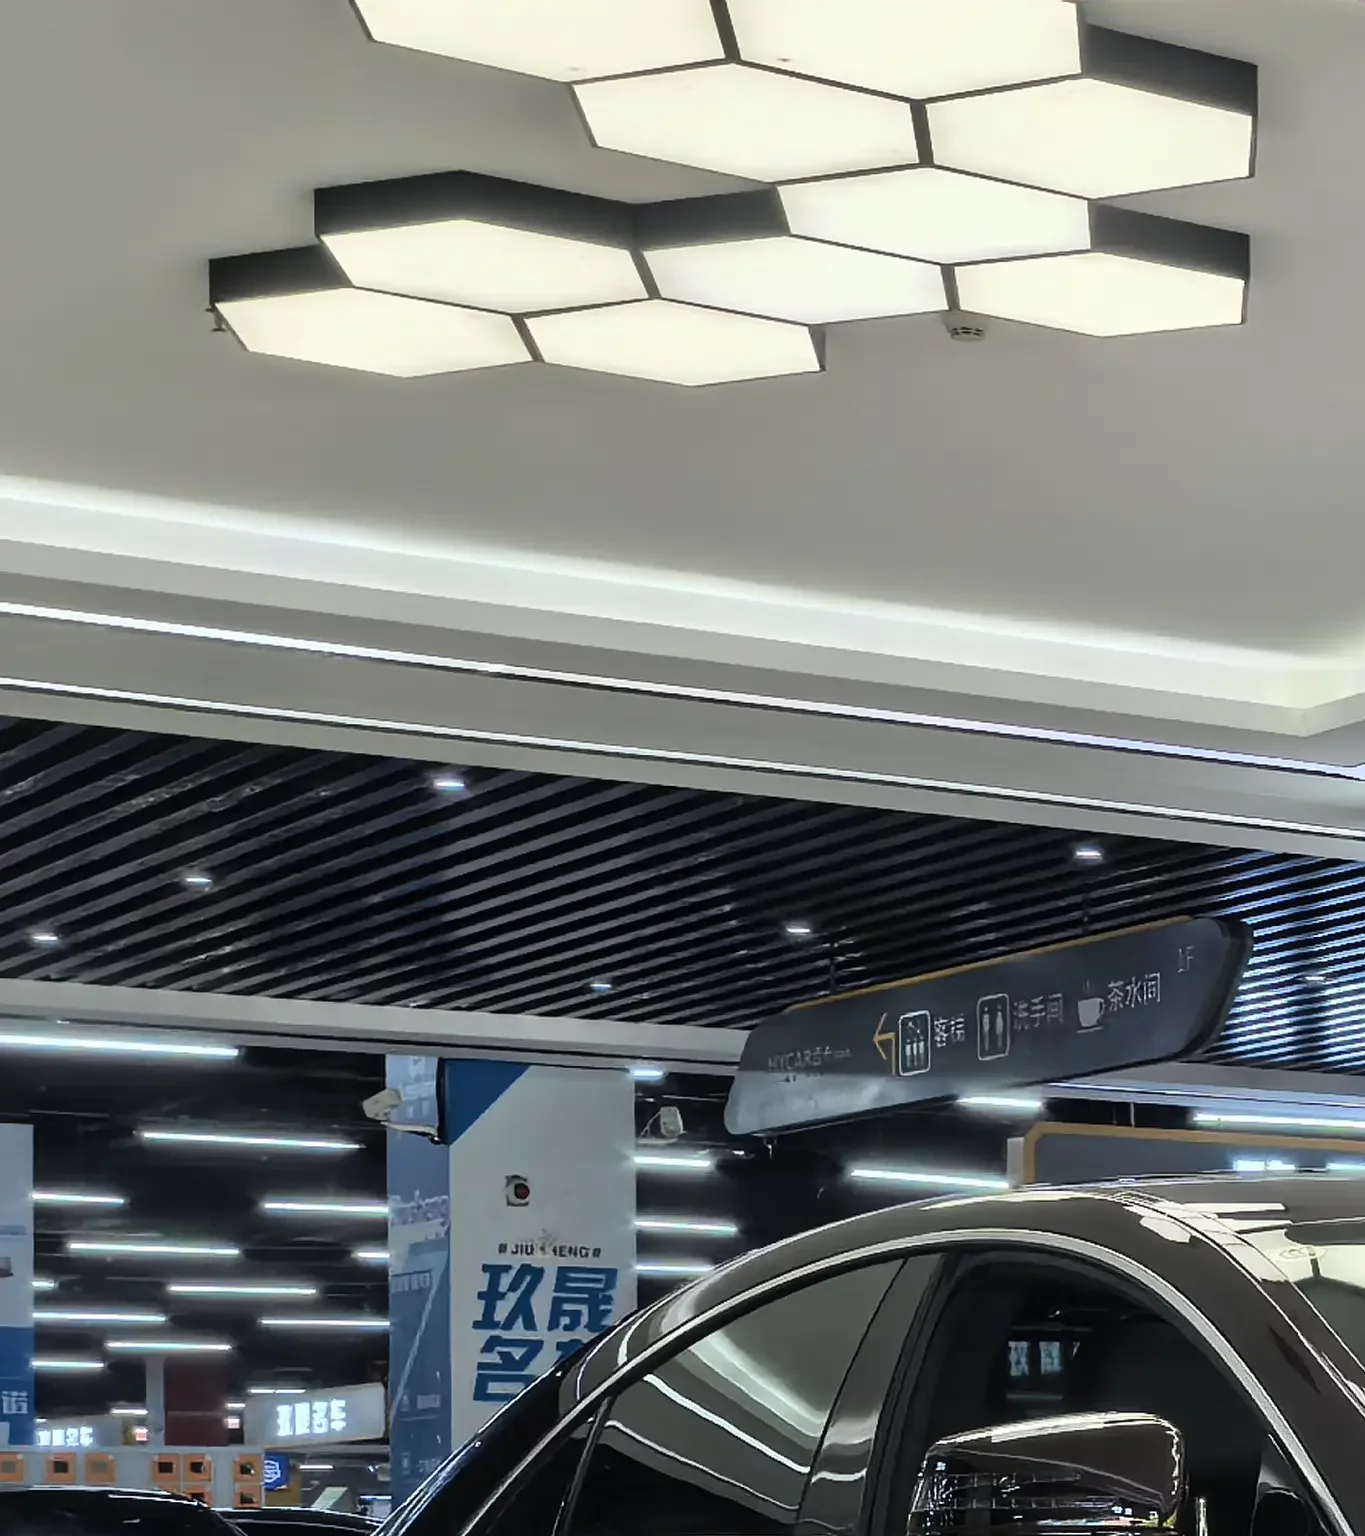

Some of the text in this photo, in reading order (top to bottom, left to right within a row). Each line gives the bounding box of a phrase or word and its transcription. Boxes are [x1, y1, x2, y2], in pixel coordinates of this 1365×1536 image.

[1107, 973, 1160, 1012] 茶水间
[472, 1262, 618, 1332] 玖晟
[473, 1335, 586, 1401] 名
